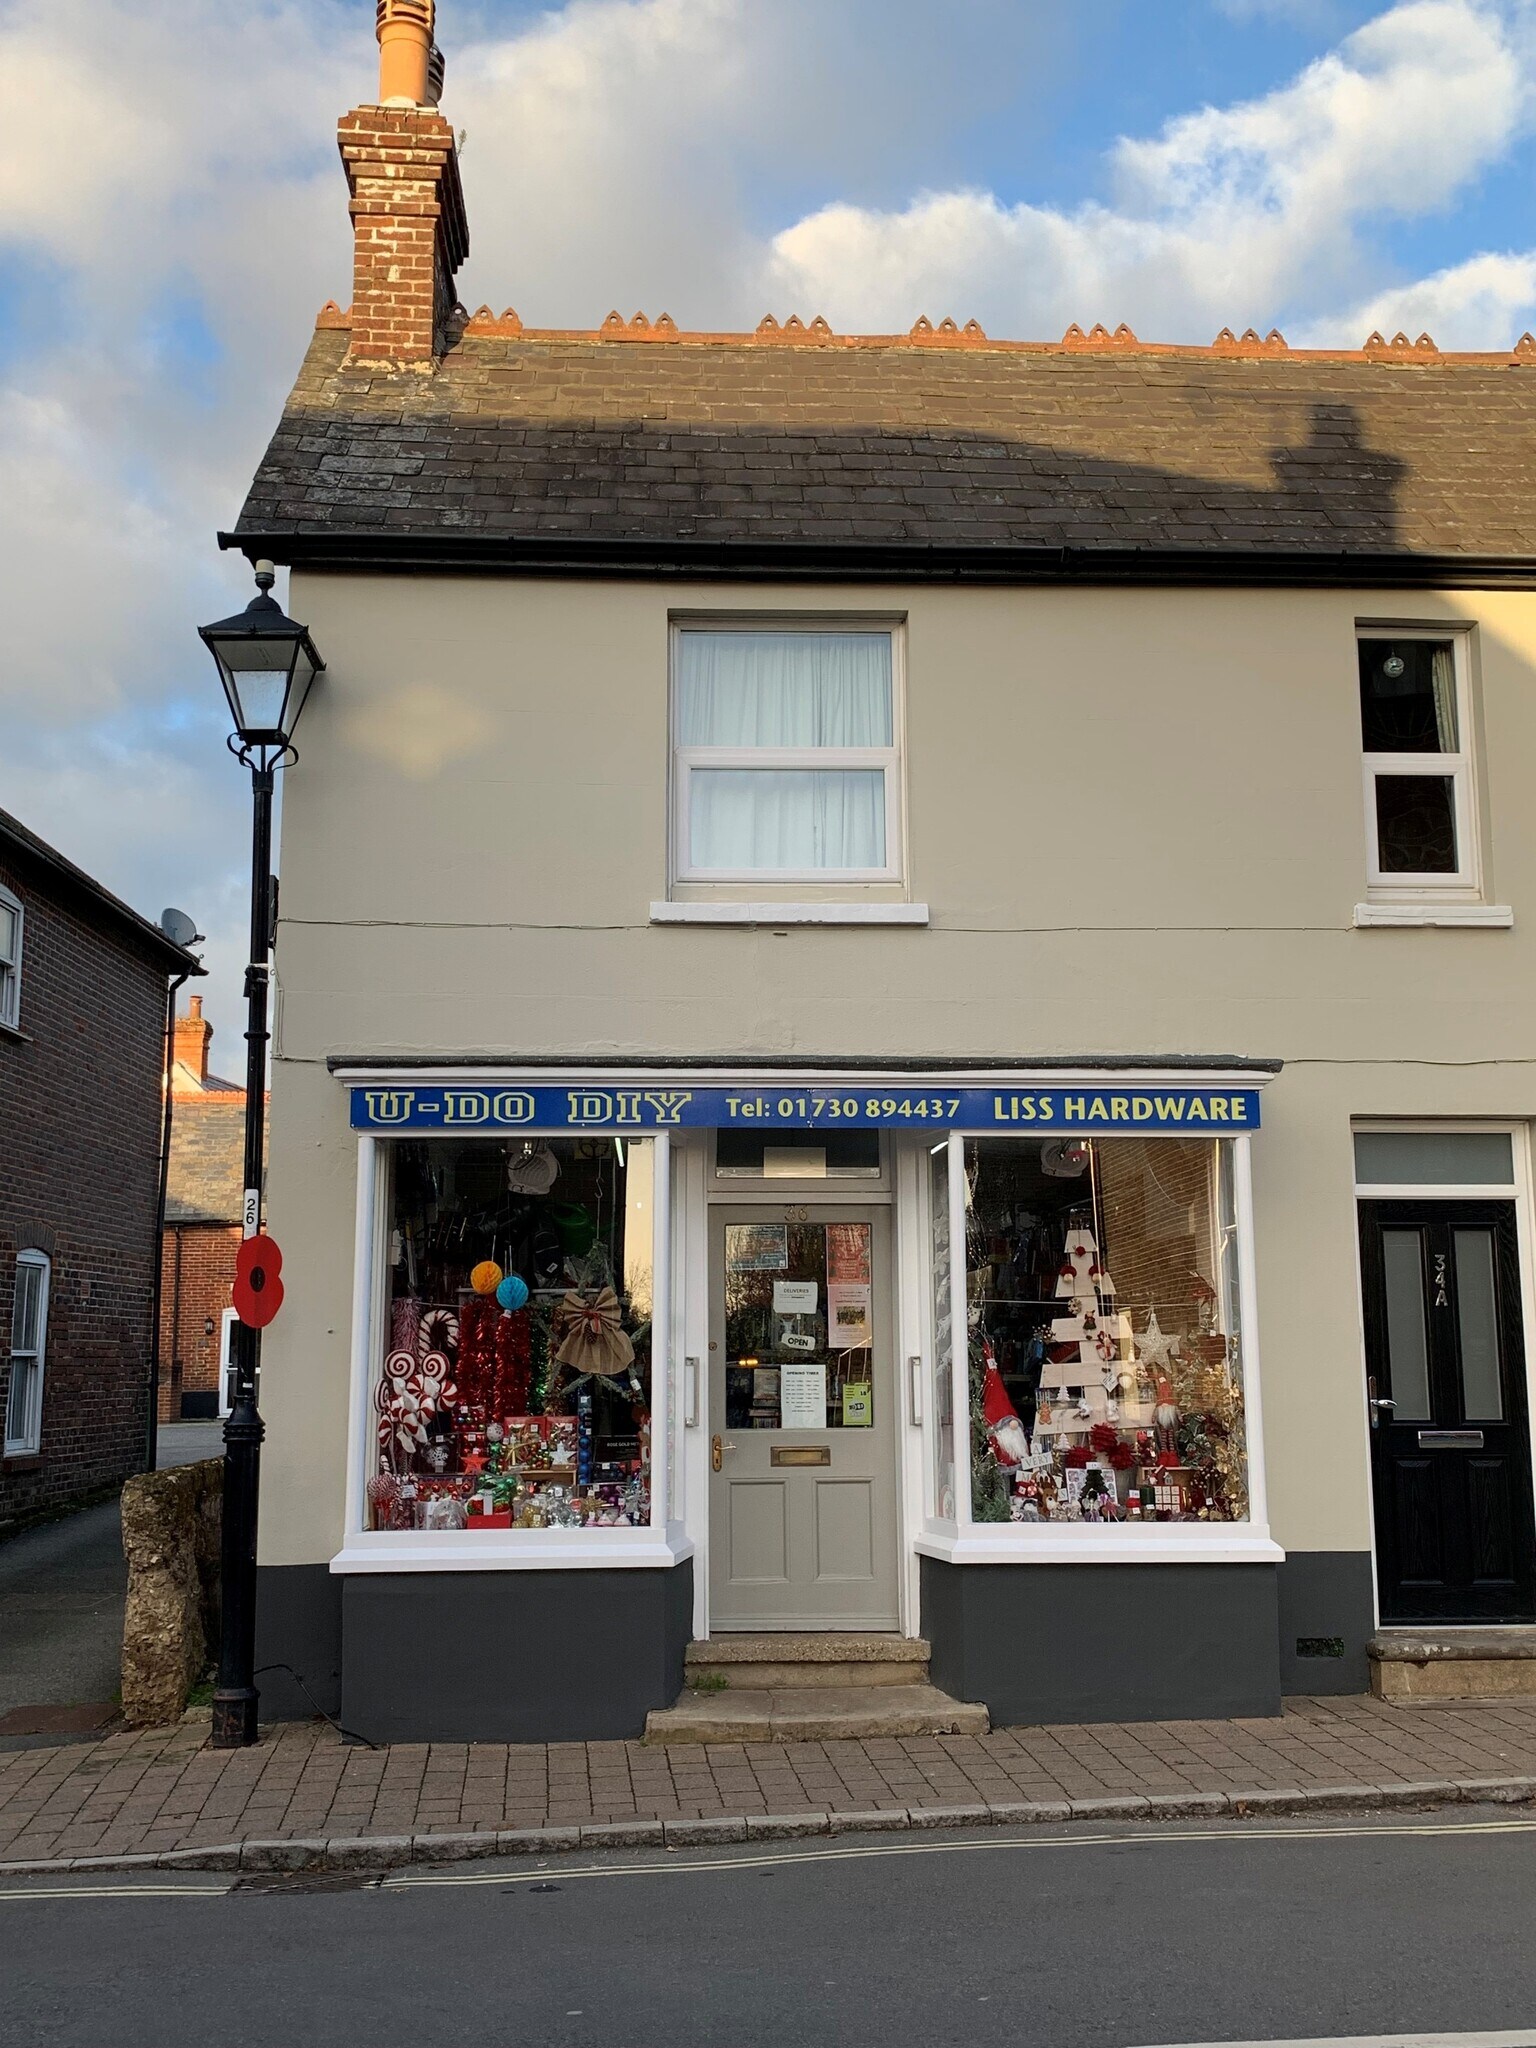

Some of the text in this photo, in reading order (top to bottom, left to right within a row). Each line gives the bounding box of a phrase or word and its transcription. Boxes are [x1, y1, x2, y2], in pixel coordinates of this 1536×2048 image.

[365, 1091, 692, 1124] U-DO DIY
[726, 1098, 960, 1119] Tel: 01730 894437
[994, 1096, 1248, 1121] LISS HARDWARE
[246, 1198, 256, 1225] 26
[787, 1337, 809, 1347] OPEN
[1025, 1453, 1050, 1466] VERY
